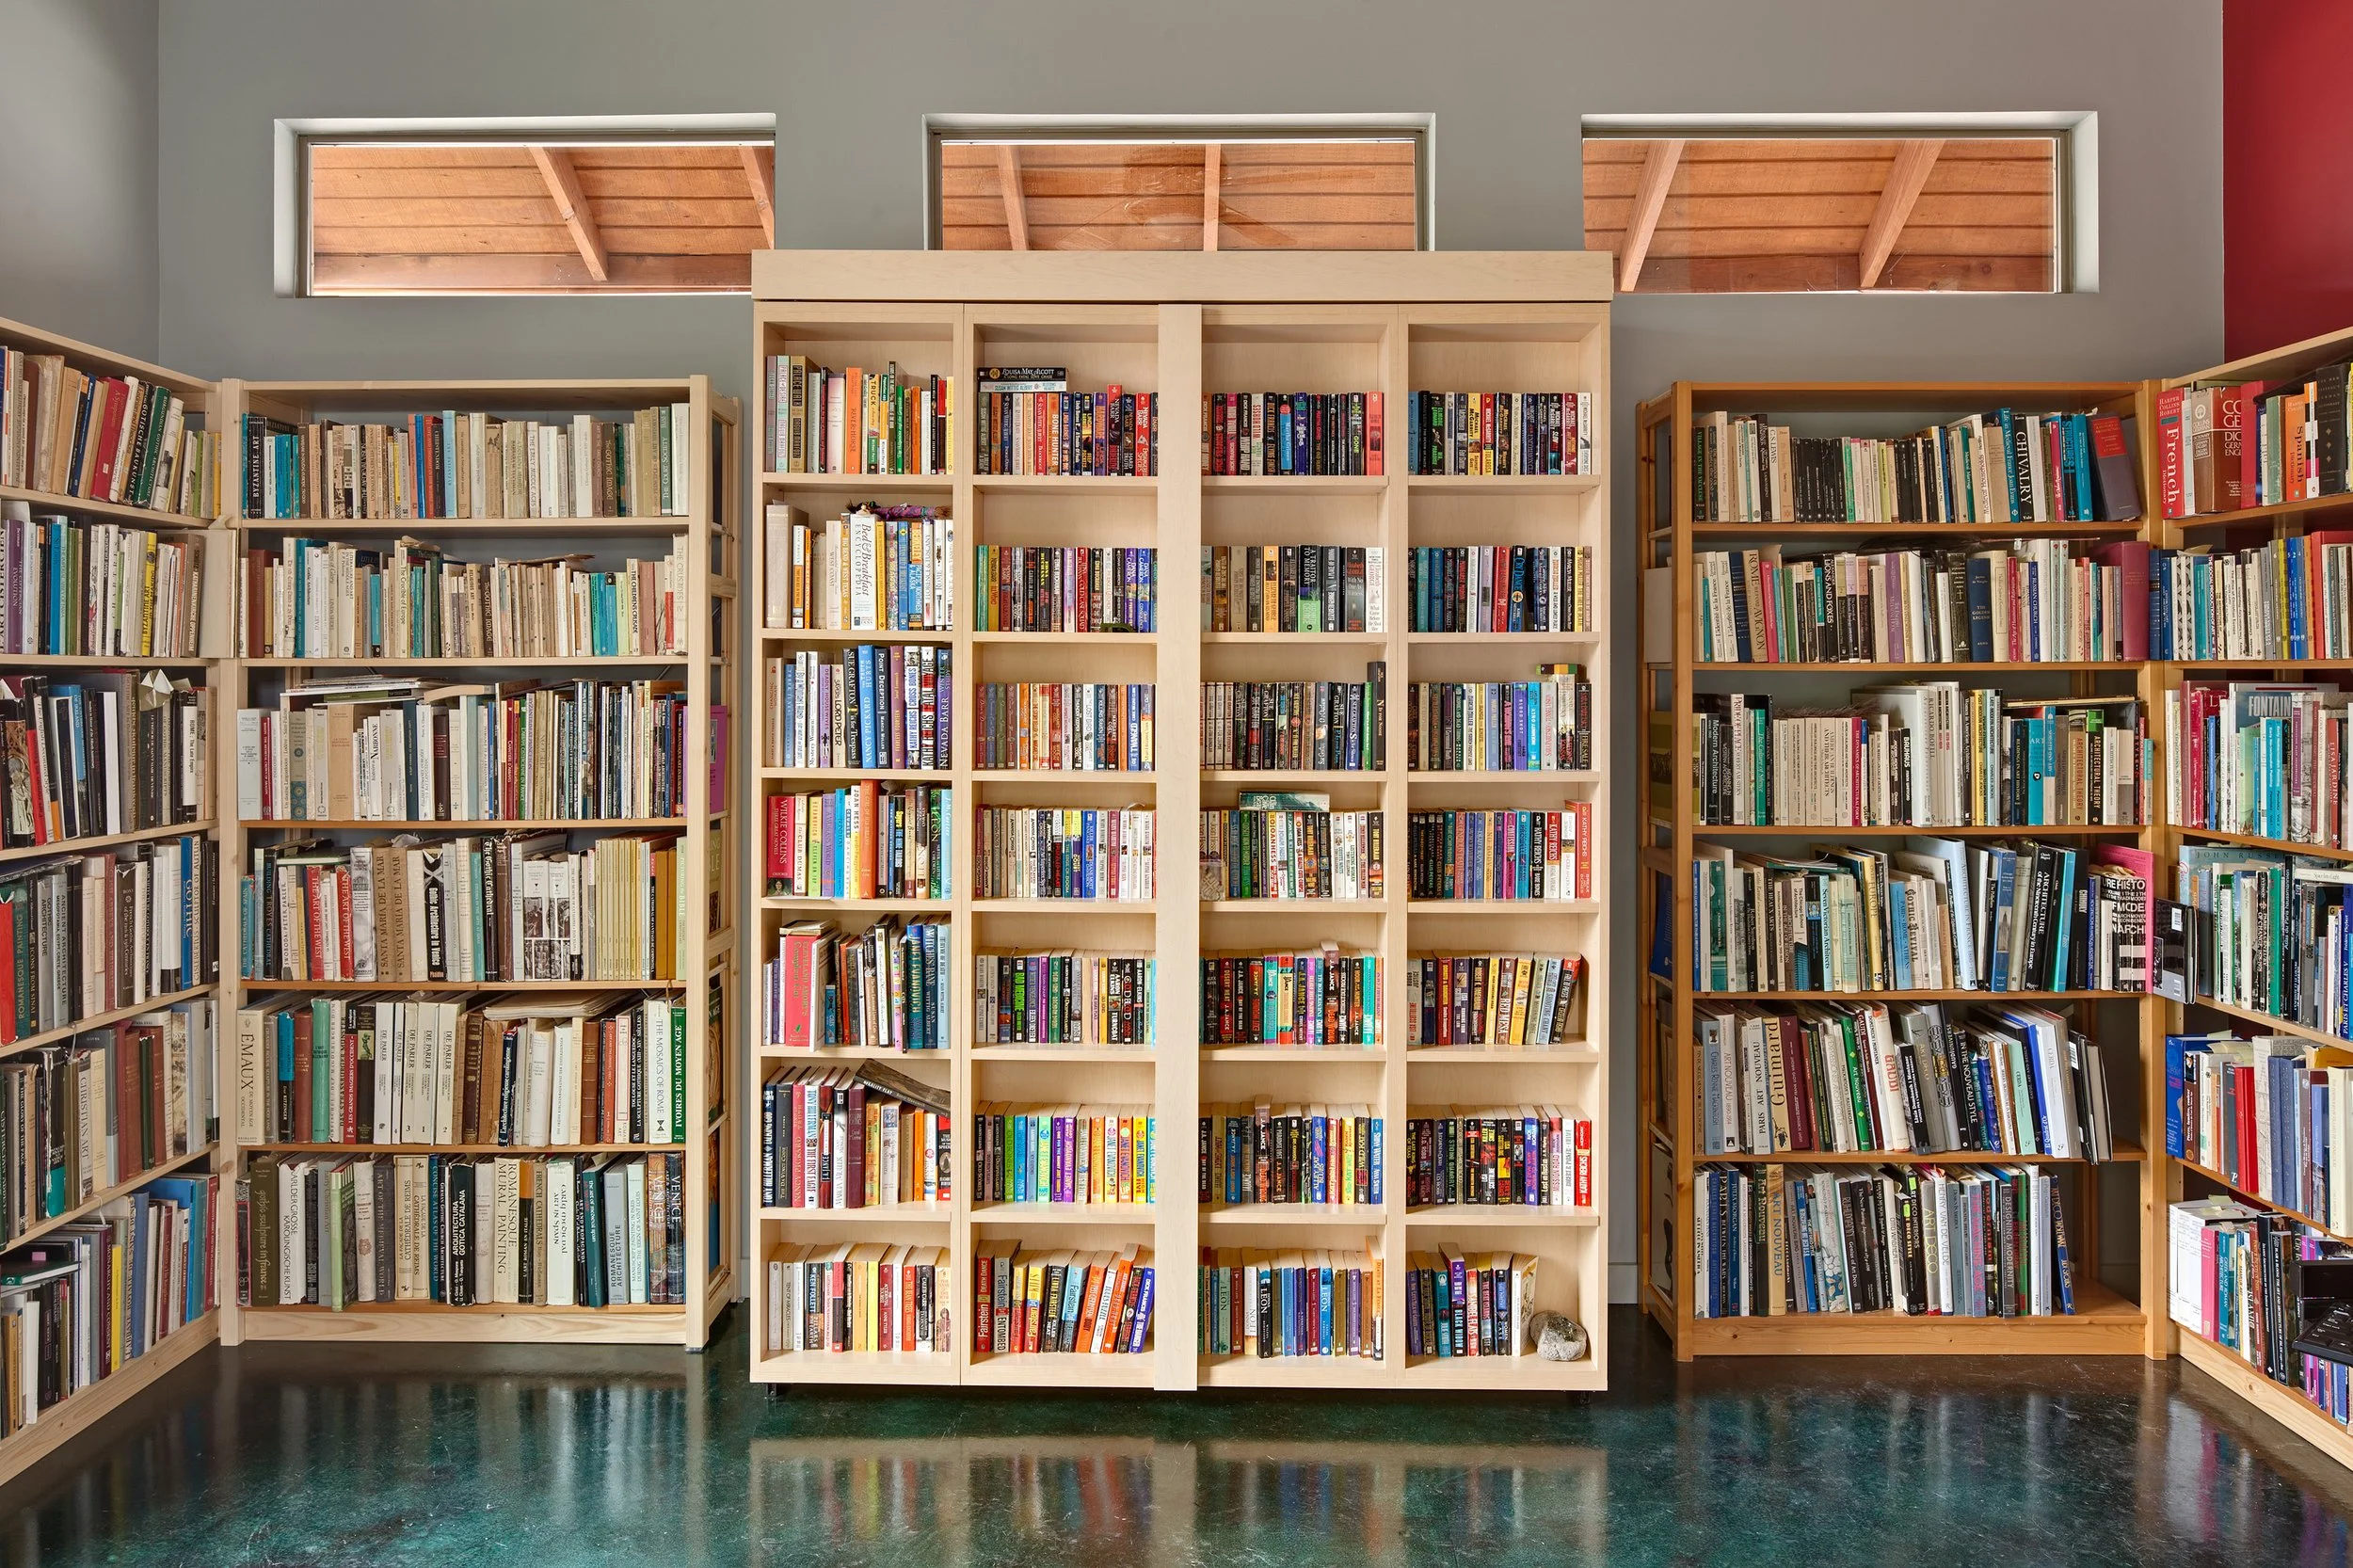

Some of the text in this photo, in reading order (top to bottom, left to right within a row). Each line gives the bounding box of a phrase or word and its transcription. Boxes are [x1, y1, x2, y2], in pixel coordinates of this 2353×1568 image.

[2064, 421, 2075, 468] STRUCTURES
[2295, 426, 2304, 482] Spanish
[2016, 432, 2031, 504] CHIVALRY
[2166, 428, 2179, 503] French
[859, 554, 872, 595] Breakfast
[1824, 559, 1832, 579] LIONS
[1749, 554, 1765, 650] ROME AVIGNON
[848, 705, 858, 715] T
[371, 723, 379, 760] NARBONNE
[940, 698, 948, 767] NEVADA BARR
[378, 877, 386, 889] LA
[379, 893, 386, 904] DE
[394, 878, 401, 889] LA
[395, 893, 402, 905] DE
[429, 888, 438, 905] Gothic
[2039, 872, 2049, 934] ARCHITECTURE
[314, 913, 320, 923] OF
[430, 906, 440, 940] Architecture
[1905, 889, 1919, 962] GOTHIC REVIVAL
[431, 947, 441, 966] Venice
[241, 1034, 255, 1090] ÉMAUX
[1753, 1042, 1762, 1082] NOUVEAU
[1766, 1022, 1785, 1106] Guimard
[656, 1077, 663, 1088] OF
[675, 1078, 682, 1090] DU
[1963, 1065, 1974, 1101] NOUVEAU
[1969, 1103, 1977, 1123] STYLE
[80, 1077, 88, 1137] CHRISTIAN
[764, 1153, 772, 1187] HILLERMAN
[404, 1203, 411, 1212] DE
[507, 1164, 517, 1247] ROMANESQUE
[653, 1175, 664, 1222] VENICE
[670, 1175, 681, 1223] VENICE
[764, 1188, 772, 1203] TONY
[498, 1163, 506, 1274] MURAL PAINTING
[1924, 1208, 1938, 1273] ART DECO
[997, 1275, 1007, 1350] Fairstein ENTOMBED
[1068, 1285, 1079, 1313] Fairstein
[977, 1304, 989, 1337] Fairstein
